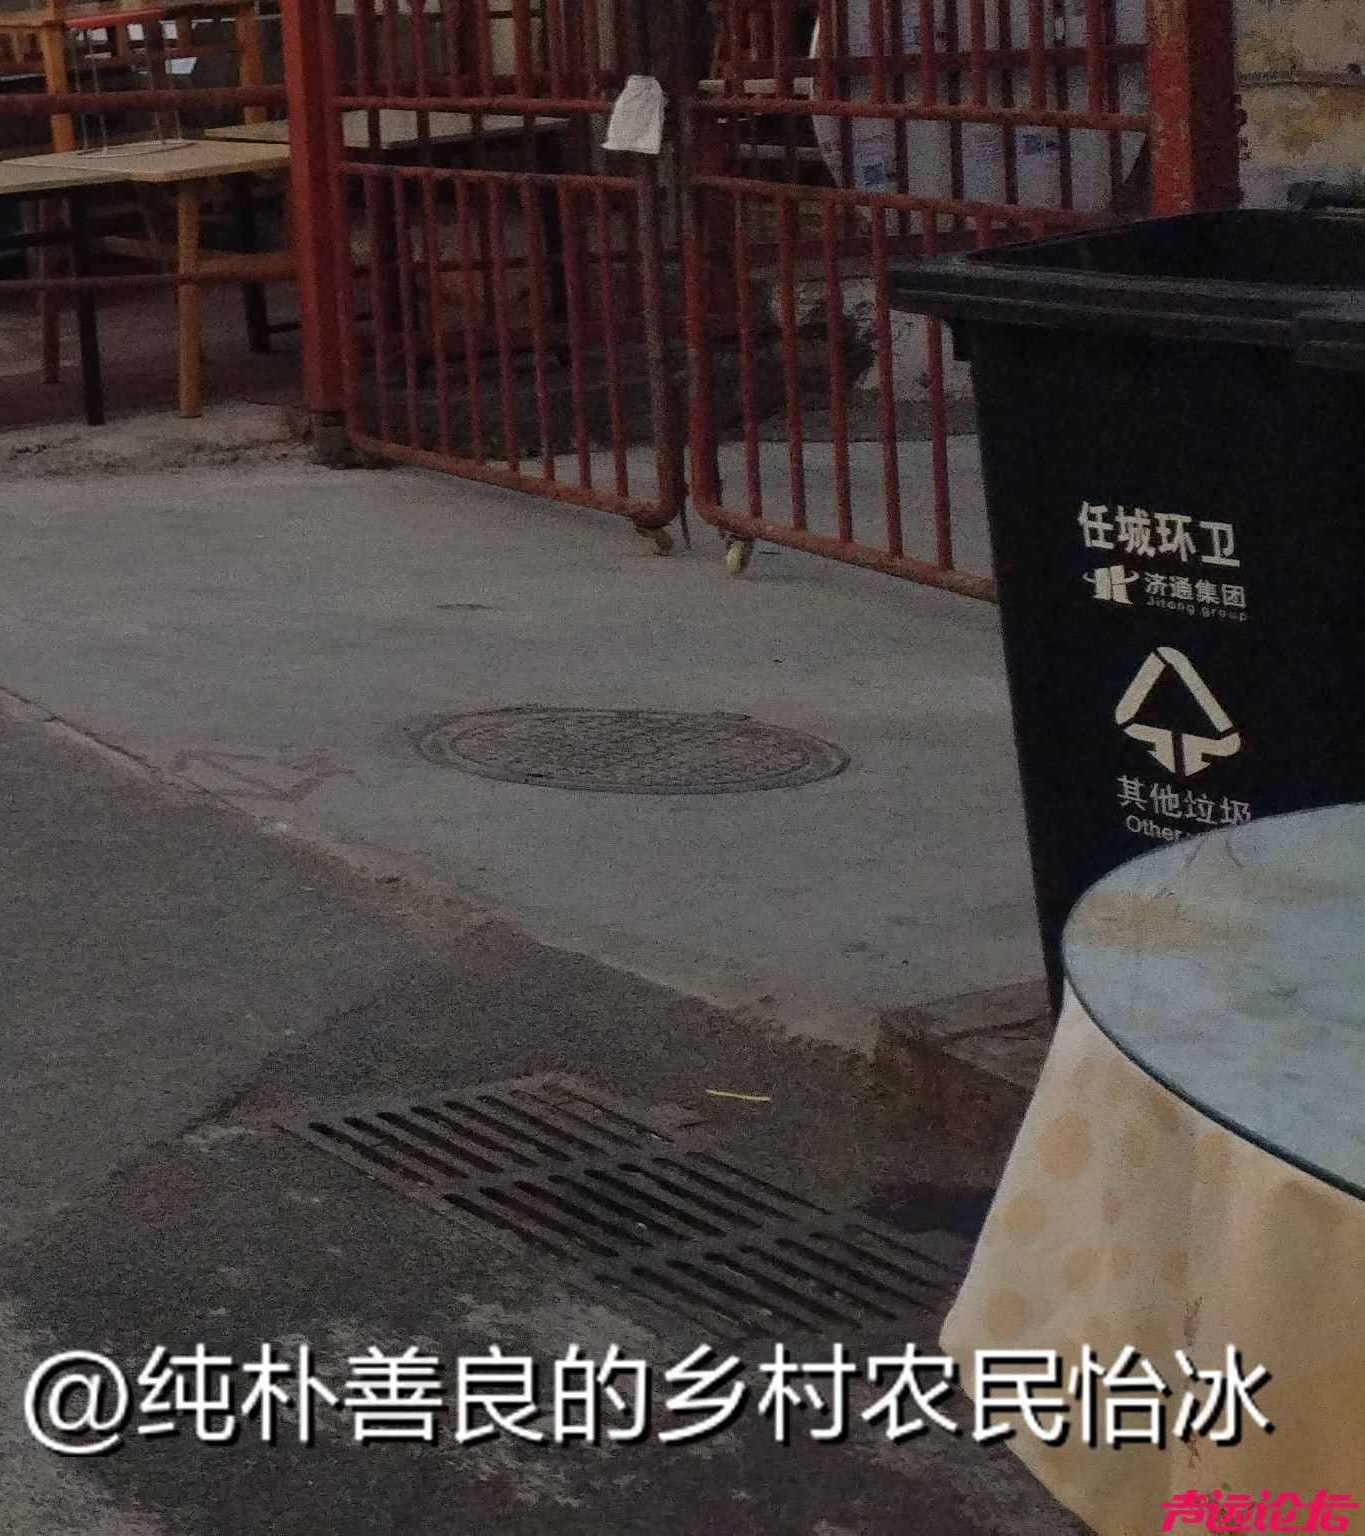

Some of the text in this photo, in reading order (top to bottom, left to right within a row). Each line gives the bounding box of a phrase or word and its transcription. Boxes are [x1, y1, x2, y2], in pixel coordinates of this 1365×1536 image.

[1076, 500, 1241, 567] 任城环卫
[1143, 572, 1247, 609] 济通集团
[1116, 775, 1252, 826] 其他垃圾
